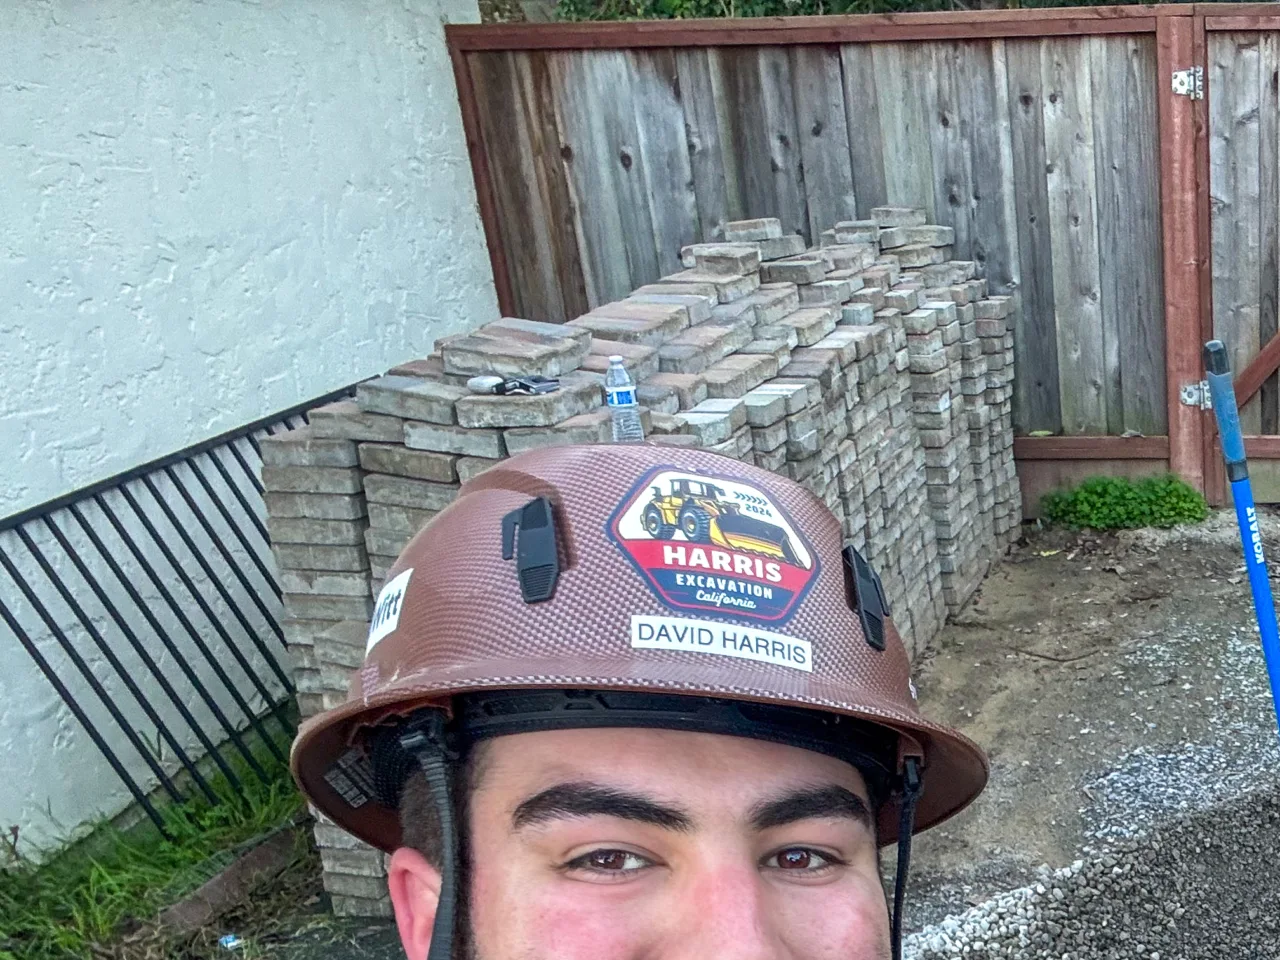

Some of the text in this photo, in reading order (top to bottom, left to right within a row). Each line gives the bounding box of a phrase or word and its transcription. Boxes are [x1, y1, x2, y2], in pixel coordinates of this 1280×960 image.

[745, 503, 773, 518] 2024
[1246, 506, 1265, 565] KOBALT
[662, 545, 782, 583] HARRIS
[675, 573, 773, 600] EXCAVATION
[695, 589, 757, 609] California
[638, 623, 807, 664] DAVID HARRIS
